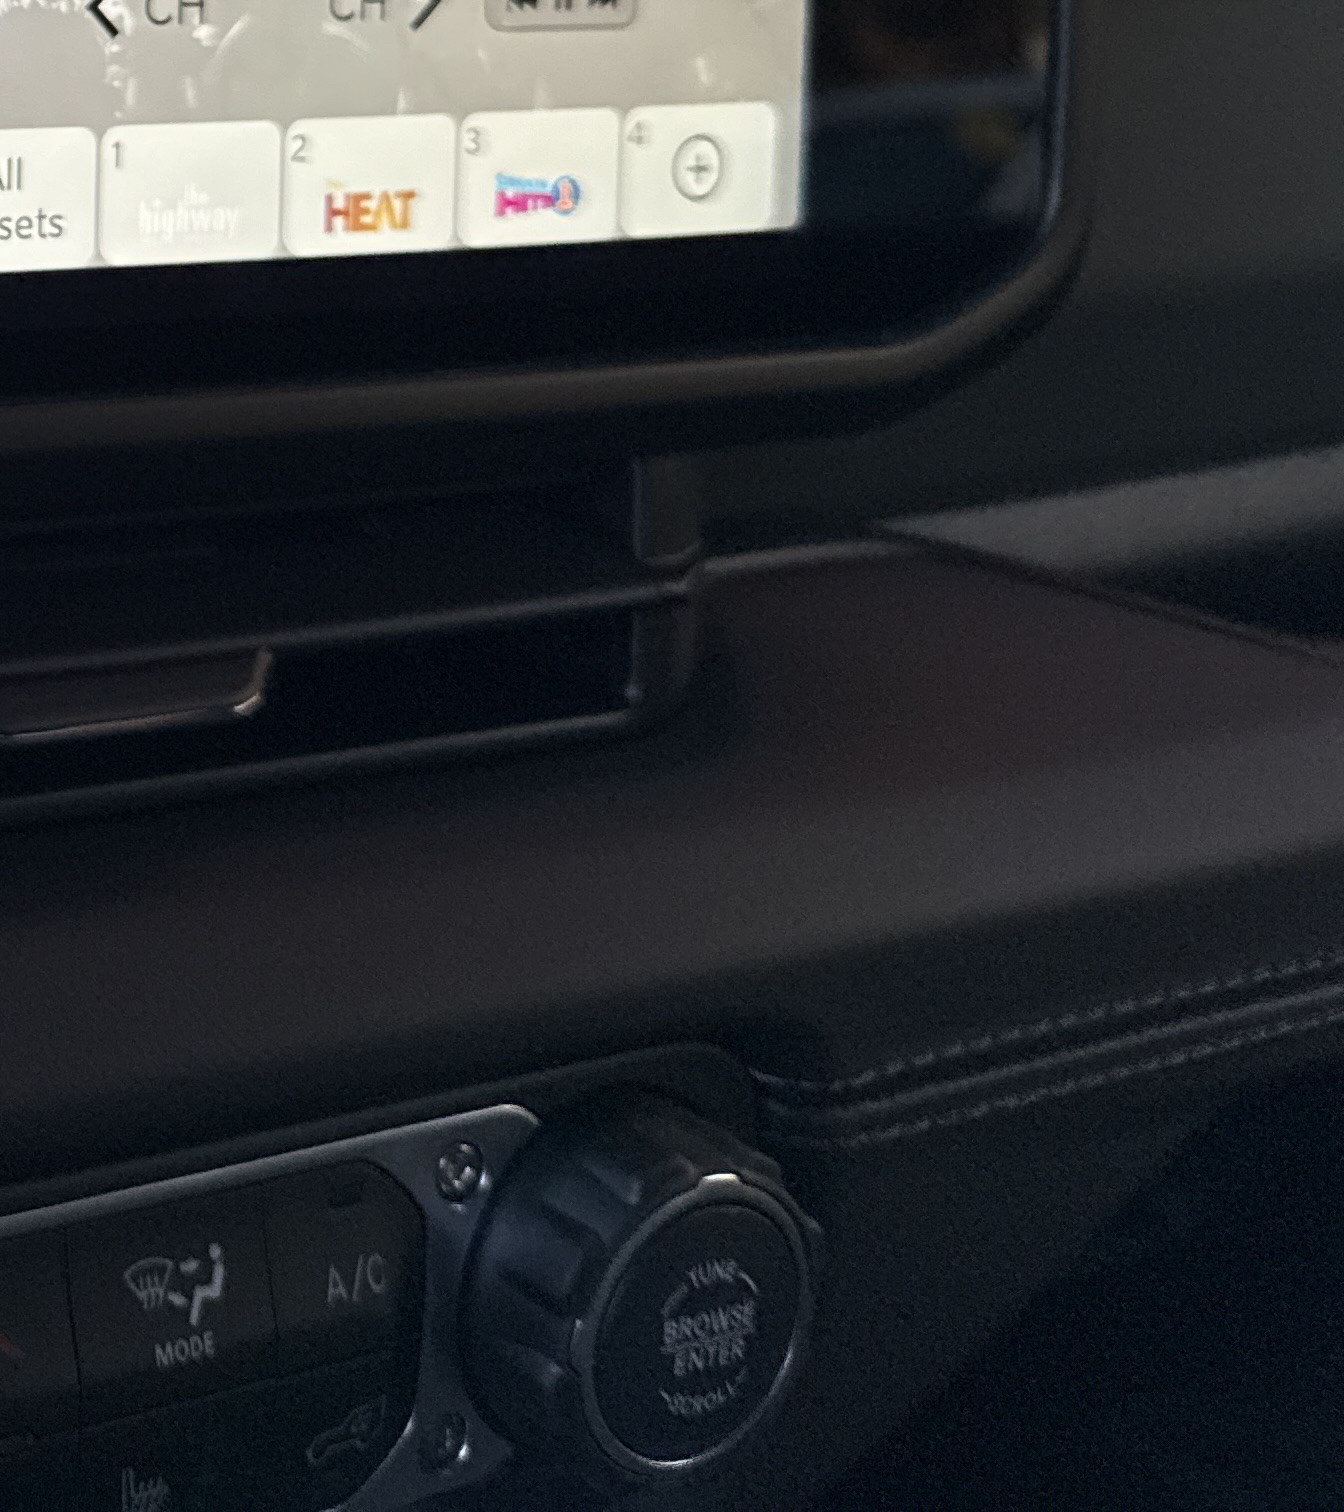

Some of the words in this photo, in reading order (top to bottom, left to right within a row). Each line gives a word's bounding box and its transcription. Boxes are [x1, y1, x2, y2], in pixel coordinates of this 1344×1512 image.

[111, 140, 124, 169] 1
[290, 133, 311, 164] 2
[464, 127, 482, 157] 3
[323, 189, 418, 233] HEAT
[326, 1252, 387, 1306] A/C
[663, 1299, 756, 1344] BROWSE
[154, 1330, 215, 1368] MODE
[673, 1337, 746, 1377] ENTER
